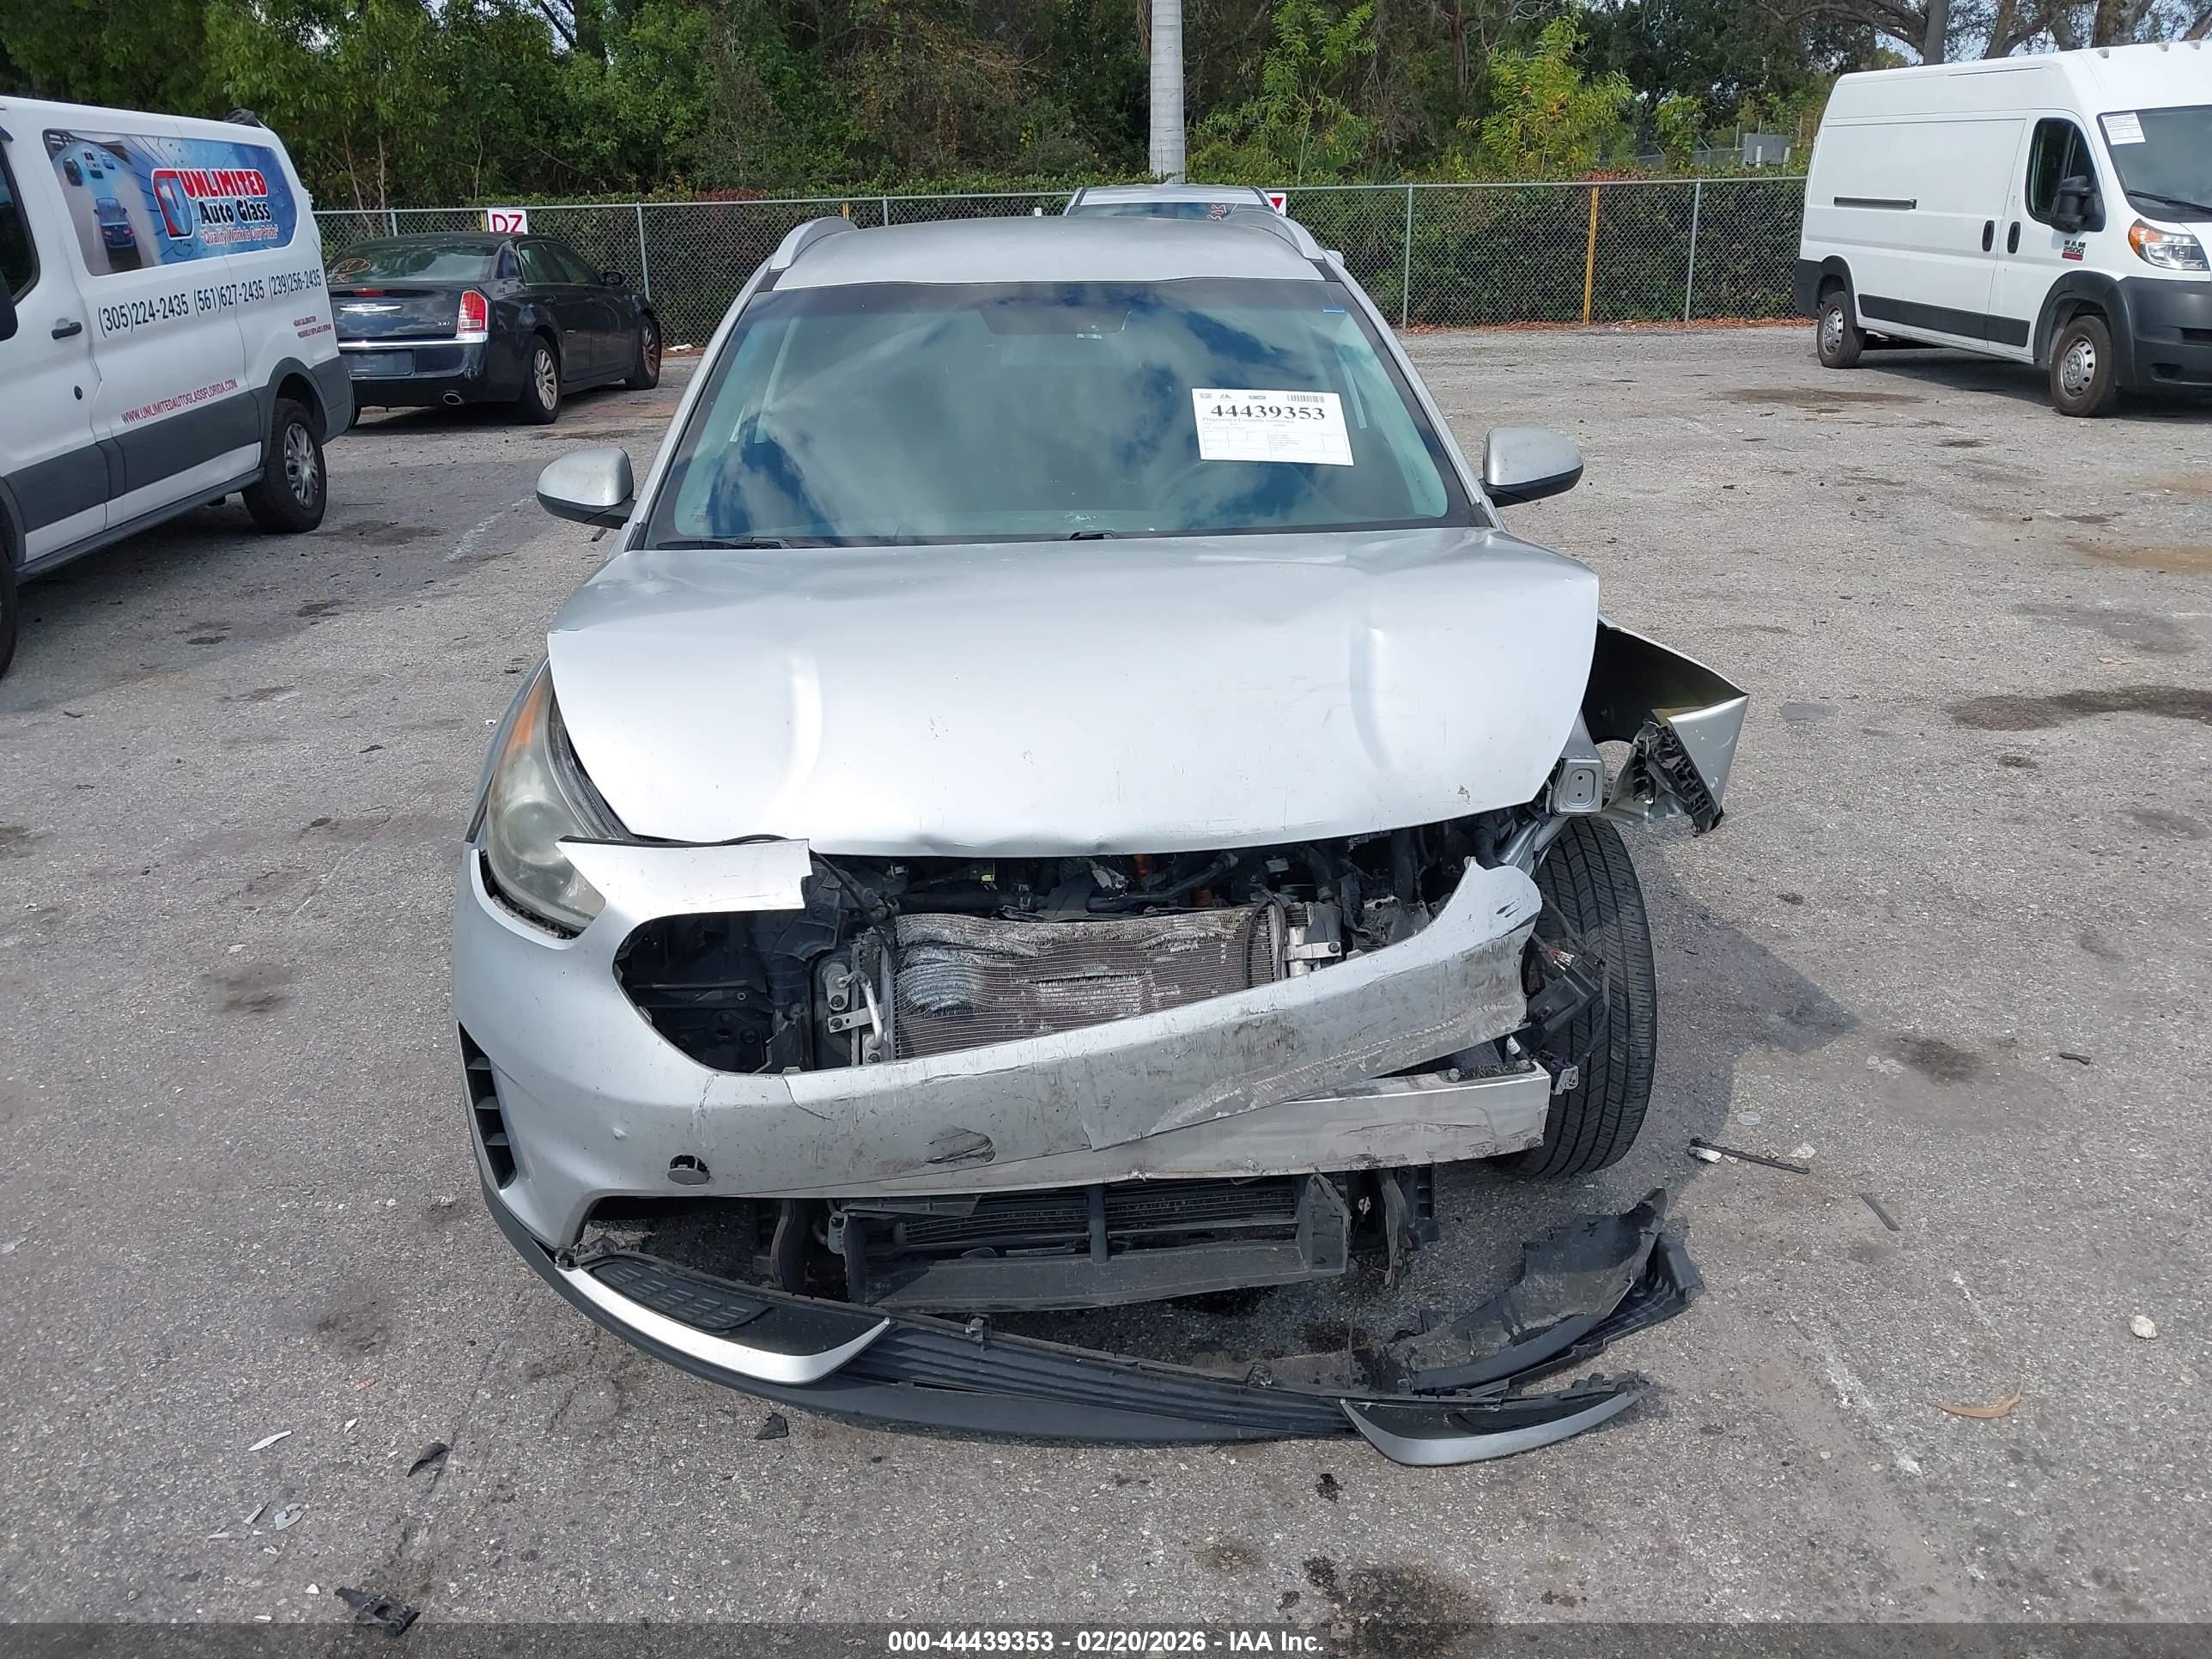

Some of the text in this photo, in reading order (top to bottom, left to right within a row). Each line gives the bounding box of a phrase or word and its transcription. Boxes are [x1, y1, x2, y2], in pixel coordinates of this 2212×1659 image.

[178, 170, 268, 198] UNLIMITED
[198, 199, 271, 224] Auto Glass
[98, 269, 321, 337] (305)224-2435 (561)627-2435 (239)256-2435
[121, 378, 238, 424] WWW.UNLIMITEDAUTOGLASSFLORIDA.COM
[1211, 404, 1325, 420] 44439353
